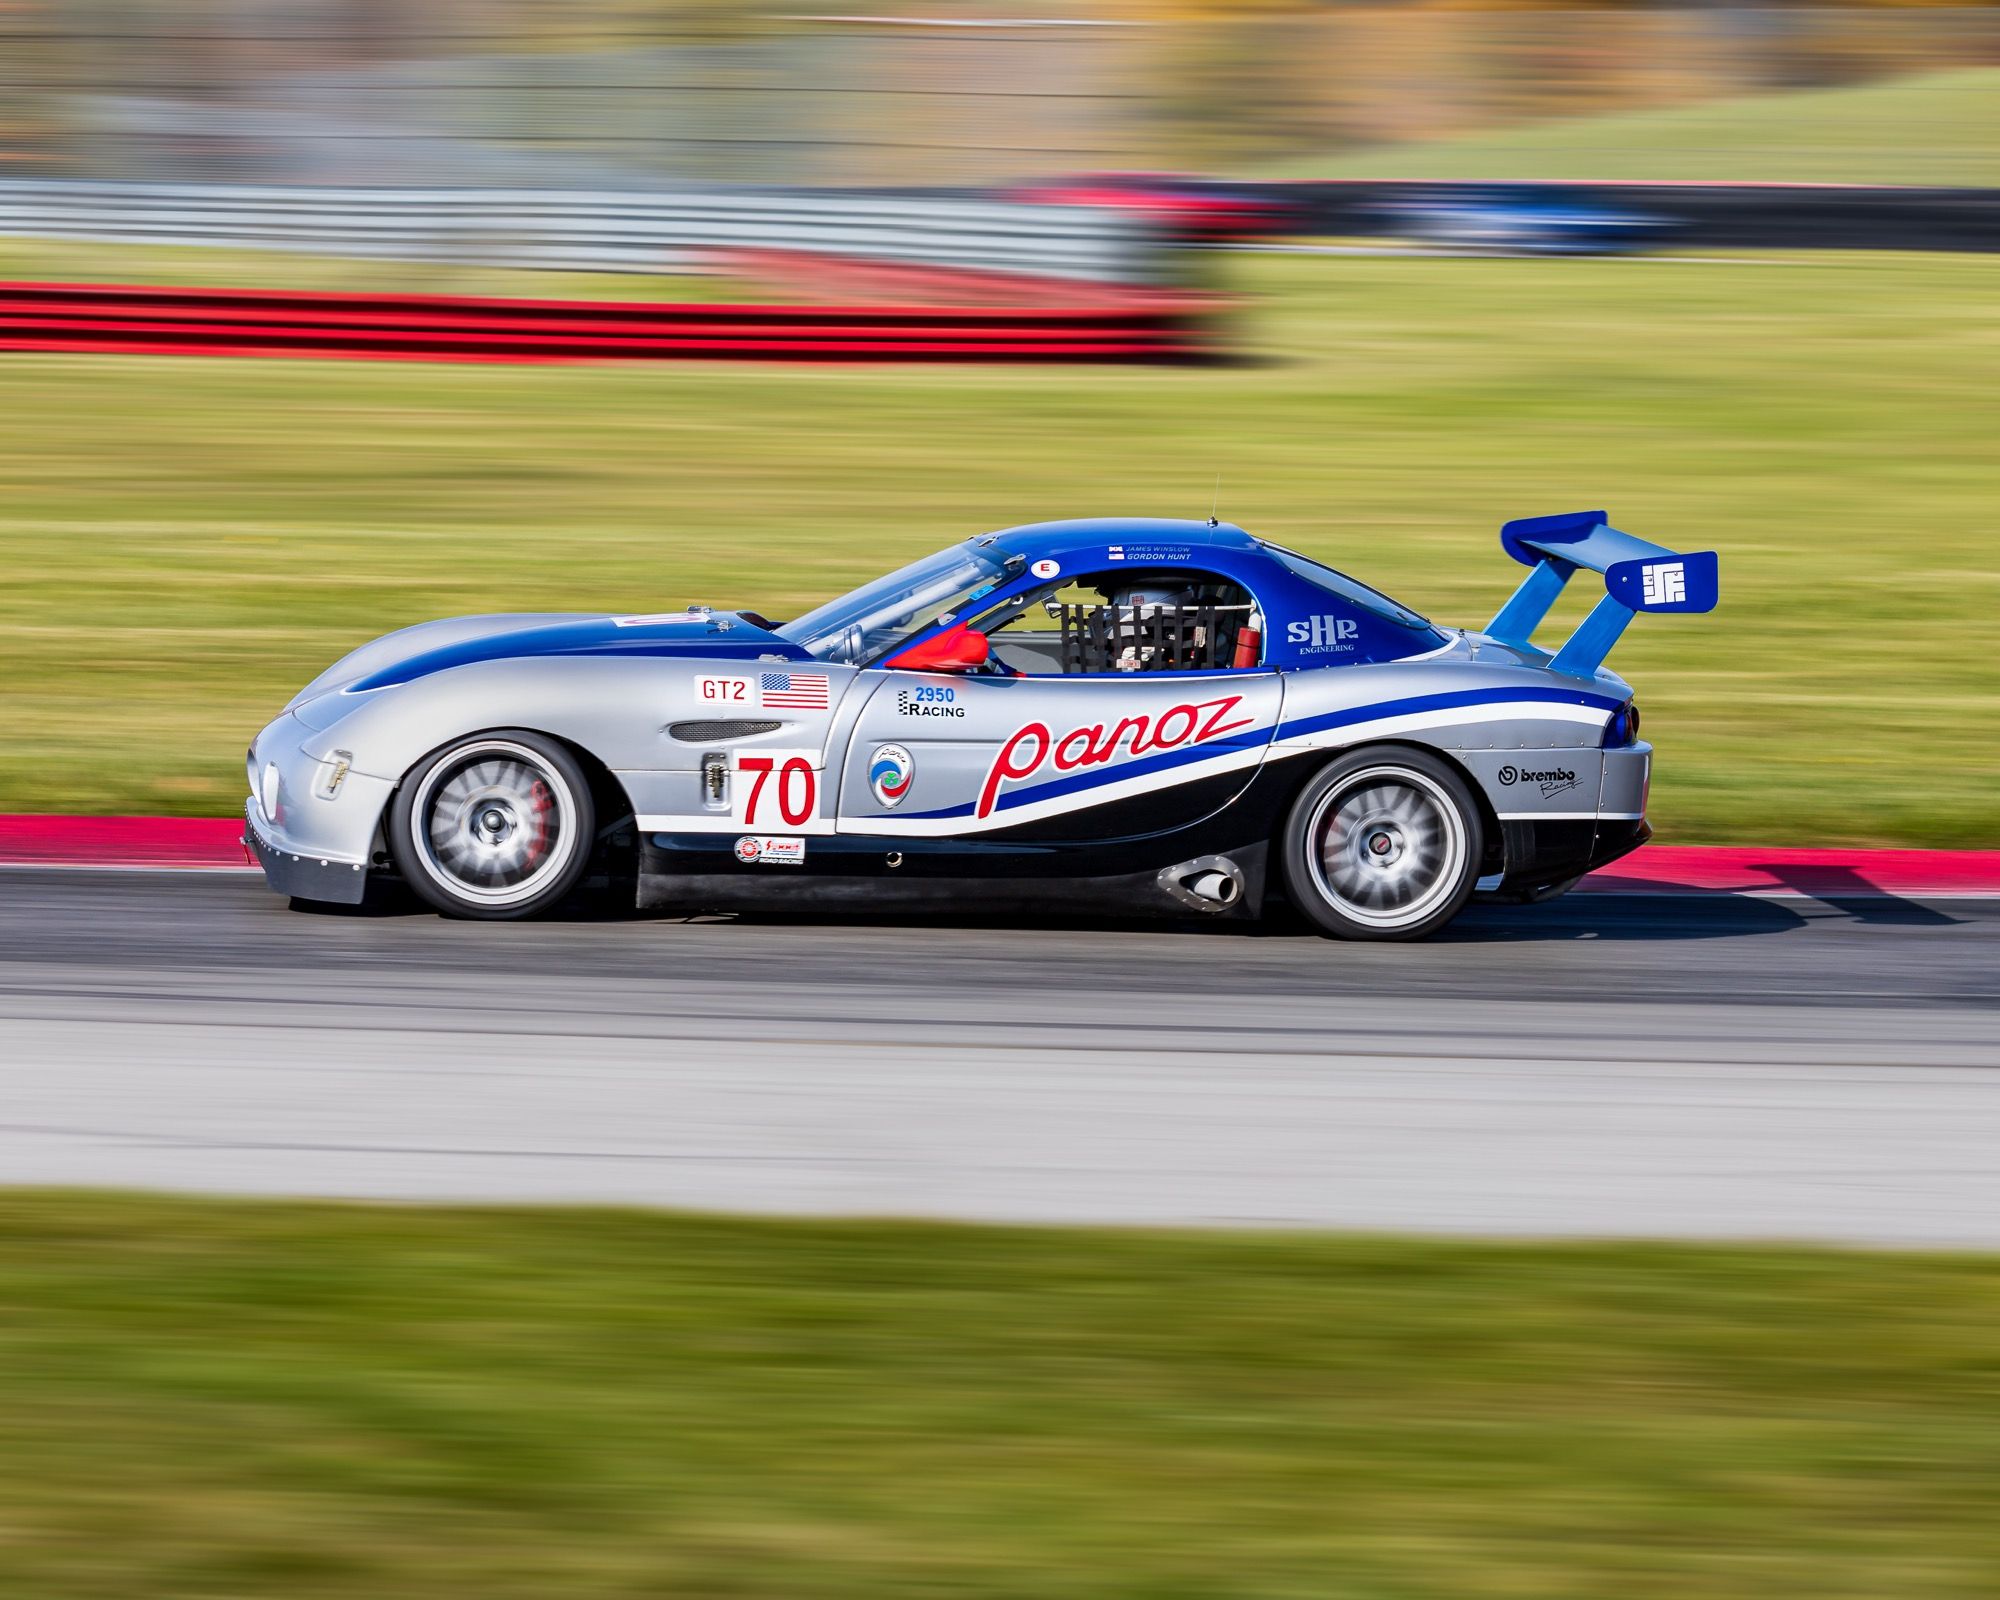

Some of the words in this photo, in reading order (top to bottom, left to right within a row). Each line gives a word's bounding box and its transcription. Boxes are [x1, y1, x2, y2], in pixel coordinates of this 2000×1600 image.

[1040, 564, 1050, 572] E
[1287, 615, 1359, 646] SHR
[1300, 645, 1354, 655] ENGINEERING
[703, 680, 746, 700] GT2
[915, 687, 955, 702] 2950
[1521, 768, 1576, 782] brembo
[738, 757, 816, 826] 70
[1540, 777, 1584, 797] Racing
